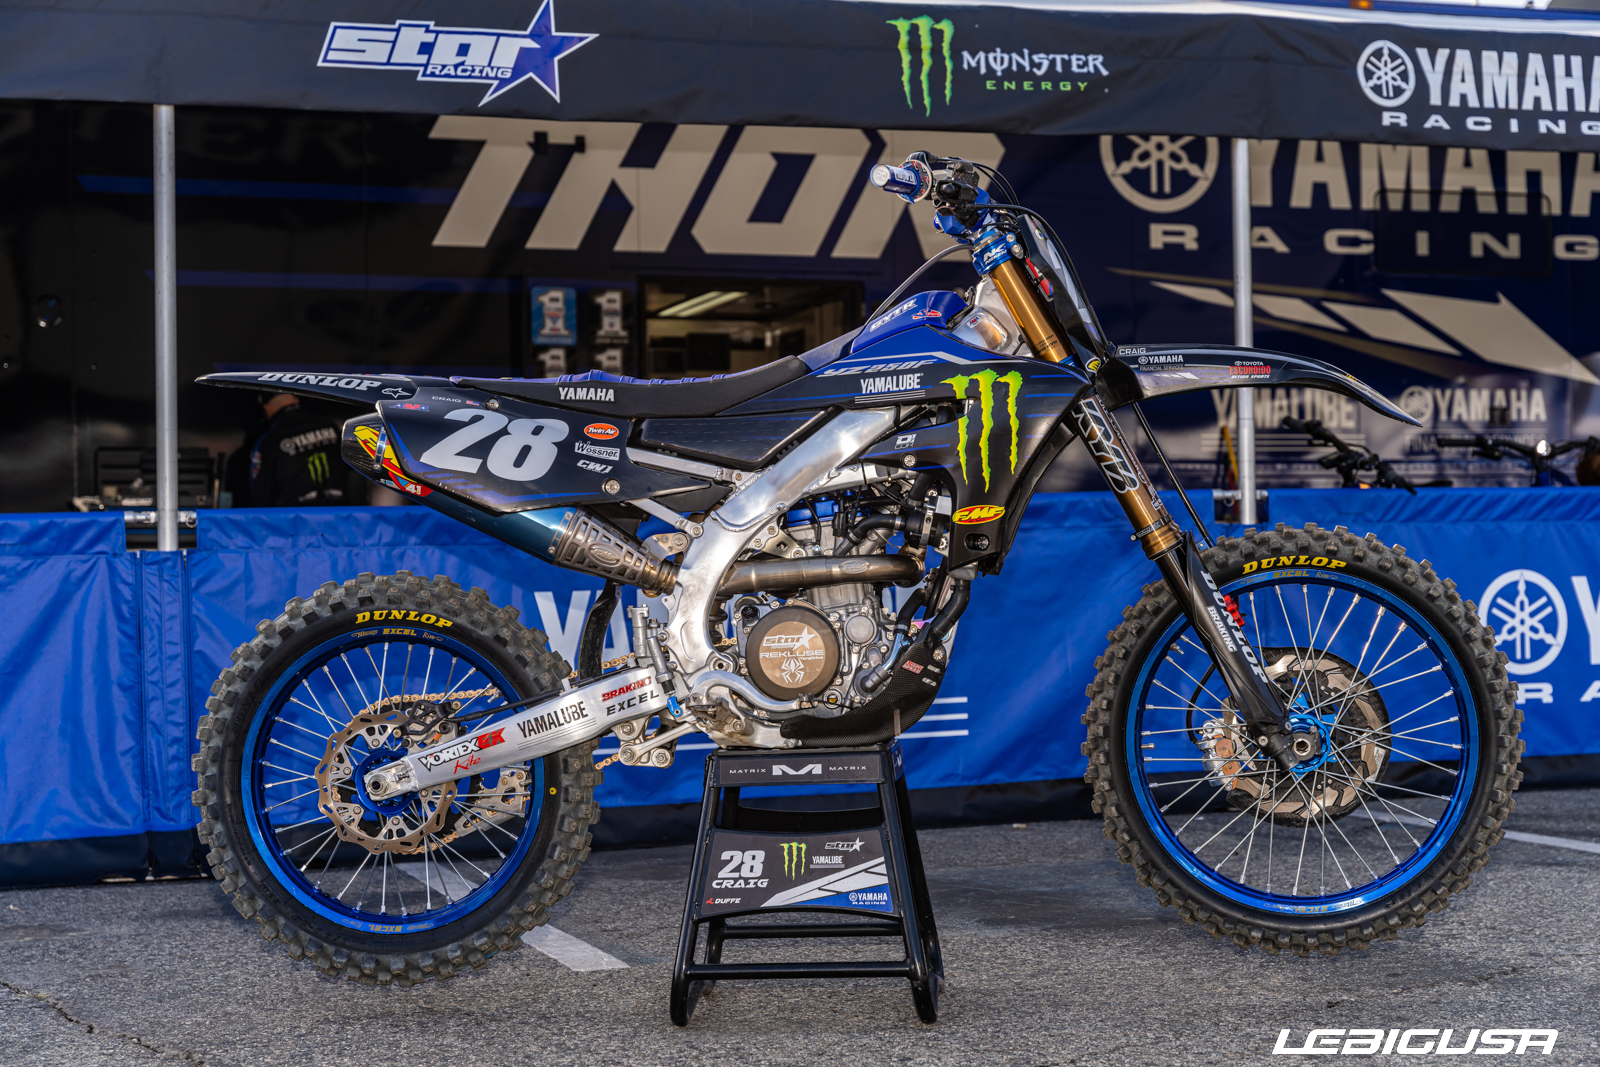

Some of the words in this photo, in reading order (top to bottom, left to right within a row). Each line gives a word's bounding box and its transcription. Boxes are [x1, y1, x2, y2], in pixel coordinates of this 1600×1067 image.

[326, 26, 541, 68] star
[962, 47, 1109, 77] MONSTER
[426, 65, 512, 79] RACING
[985, 80, 1088, 92] ENERGY
[428, 115, 1006, 260] THOR
[1149, 222, 1600, 261] RACING
[869, 298, 918, 332] GYTR
[1119, 347, 1146, 355] CRAIG
[1148, 355, 1184, 363] YAMAHA
[1230, 365, 1271, 375] ESCONDIDO
[257, 373, 382, 391] DUNLOP
[860, 373, 921, 394] YAMALUBE
[559, 386, 615, 402] YAMAHA
[604, 427, 617, 436] Air
[419, 408, 570, 481] 28
[1071, 398, 1140, 494] KYB
[952, 506, 1005, 523] FMF
[1242, 555, 1347, 575] DUNLOP
[1273, 570, 1310, 578] EXCEL
[355, 609, 453, 628] DUNLOP
[1200, 570, 1269, 684] DUNLOP
[382, 628, 417, 636] EXCEL
[1206, 605, 1238, 653] BRAKING
[760, 649, 824, 659] REKLUSE
[601, 676, 652, 702] BRAKING
[606, 689, 660, 717] EXCEL
[516, 701, 589, 739] YAMALUBE
[418, 737, 485, 772] VORTEX
[717, 850, 766, 878] 28
[812, 855, 843, 864] YAMALUBE
[712, 878, 769, 889] CRAIG
[714, 897, 742, 905] DUFFE
[857, 892, 888, 901] YAMAHA
[368, 924, 403, 933] EXCEL
